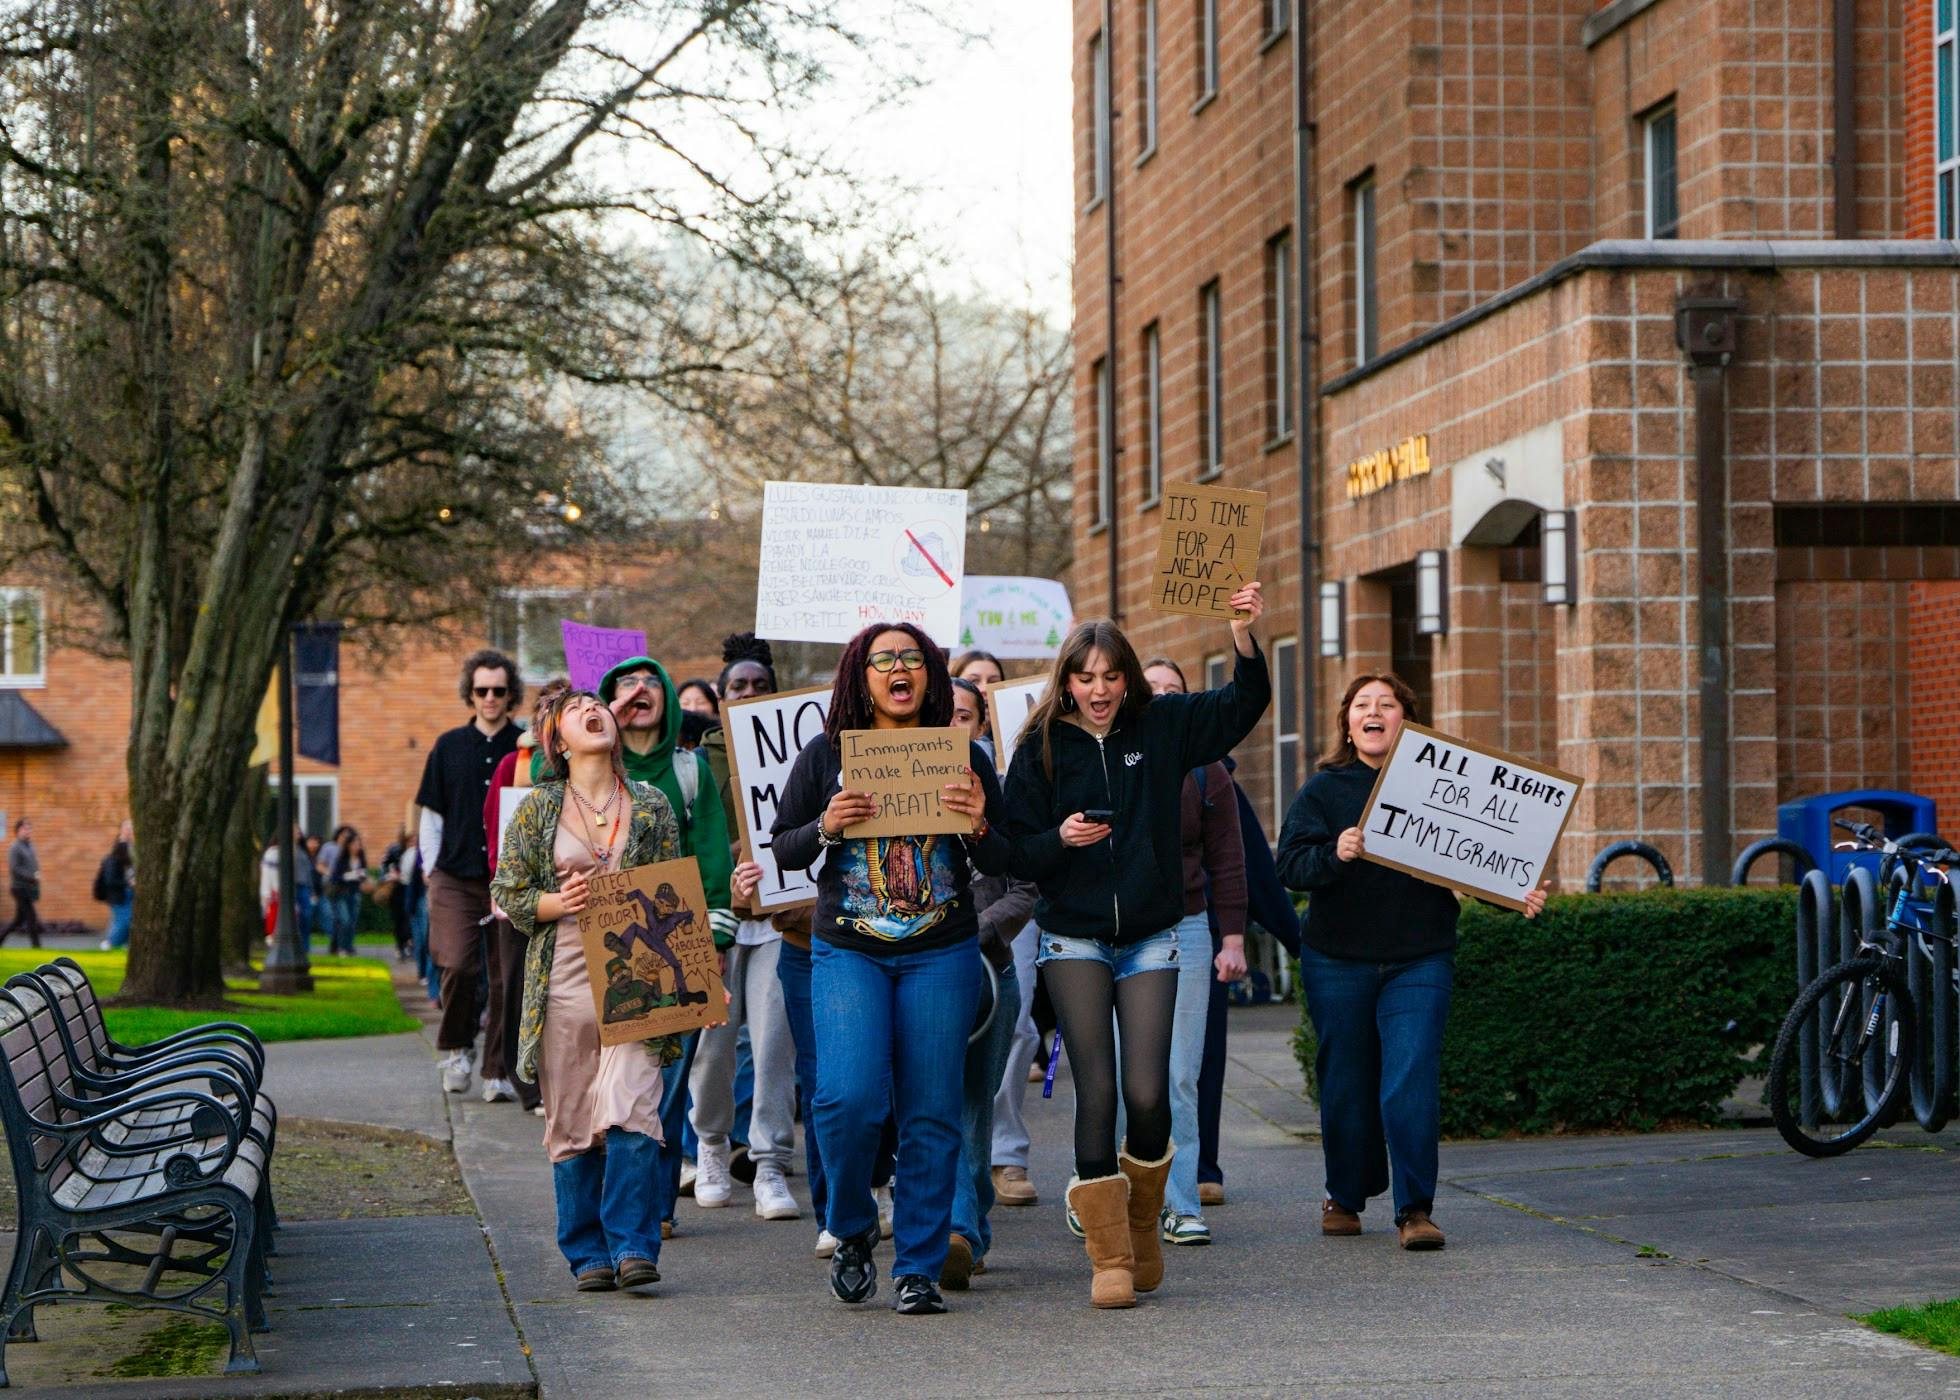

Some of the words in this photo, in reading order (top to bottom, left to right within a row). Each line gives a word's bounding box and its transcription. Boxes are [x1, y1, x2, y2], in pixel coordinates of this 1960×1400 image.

[855, 507, 905, 523] CAMPOS
[1210, 501, 1251, 527] TIME
[1176, 531, 1208, 557] FOR
[1219, 533, 1234, 559] A
[1162, 557, 1224, 579] NEW
[1163, 580, 1241, 615] HOPE
[758, 612, 792, 631] ALEX
[858, 604, 887, 619] HOW
[893, 607, 926, 622] MANY
[1020, 609, 1038, 626] ME
[576, 648, 624, 667] PEOP
[751, 701, 826, 767] NO
[847, 735, 953, 761] Immigrants
[851, 764, 902, 780] make
[1415, 742, 1469, 777] ALL
[1490, 765, 1566, 808] RIGHTS
[869, 789, 942, 819] GREAT!
[1430, 778, 1470, 808] FOR
[1480, 794, 1519, 824] ALL
[1371, 803, 1534, 887] IMMIGRANTS
[585, 870, 634, 893] ROTECT
[586, 889, 625, 909] UDENTS
[579, 916, 592, 933] OF
[598, 903, 639, 929] COLOR!
[675, 936, 713, 952] ABOLISH
